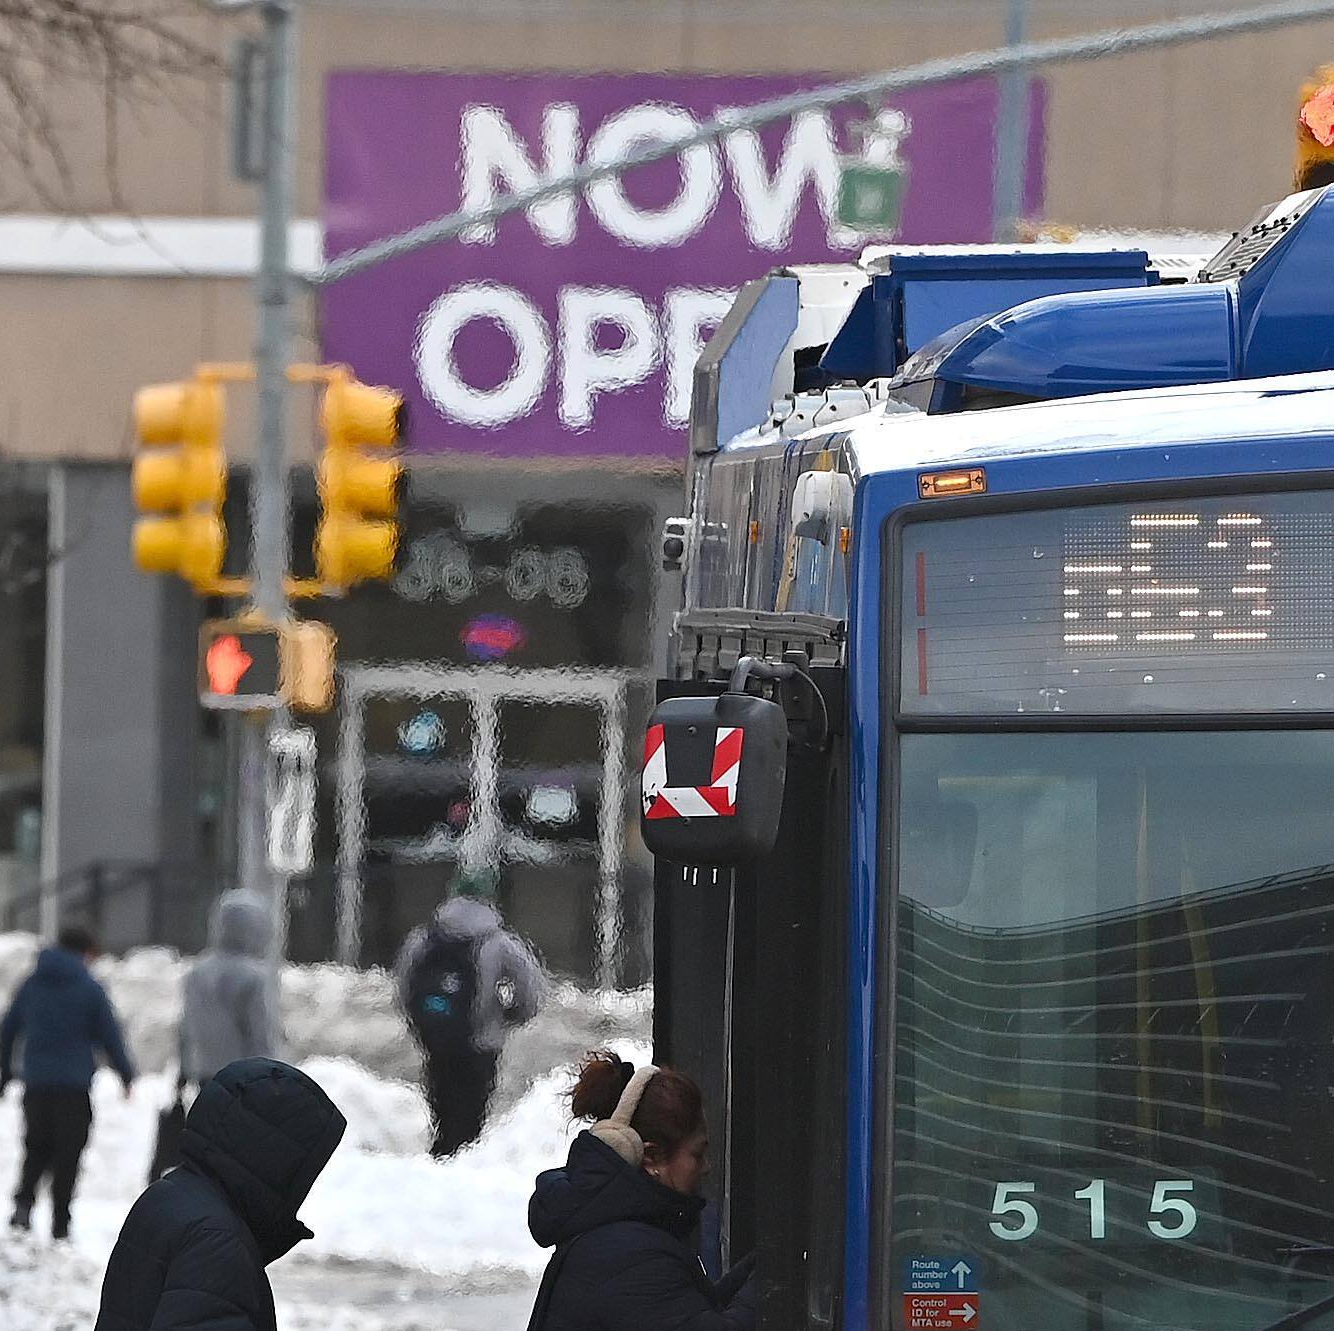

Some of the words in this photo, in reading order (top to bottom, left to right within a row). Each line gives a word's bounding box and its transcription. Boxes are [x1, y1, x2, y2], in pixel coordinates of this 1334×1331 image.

[458, 99, 911, 252] NOW
[912, 1260, 940, 1269] Route
[912, 1270, 948, 1279] number
[912, 1280, 940, 1289] above
[912, 1299, 947, 1307] Control
[912, 1309, 923, 1317] ID
[926, 1309, 940, 1317] for
[911, 1318, 933, 1327] MTA
